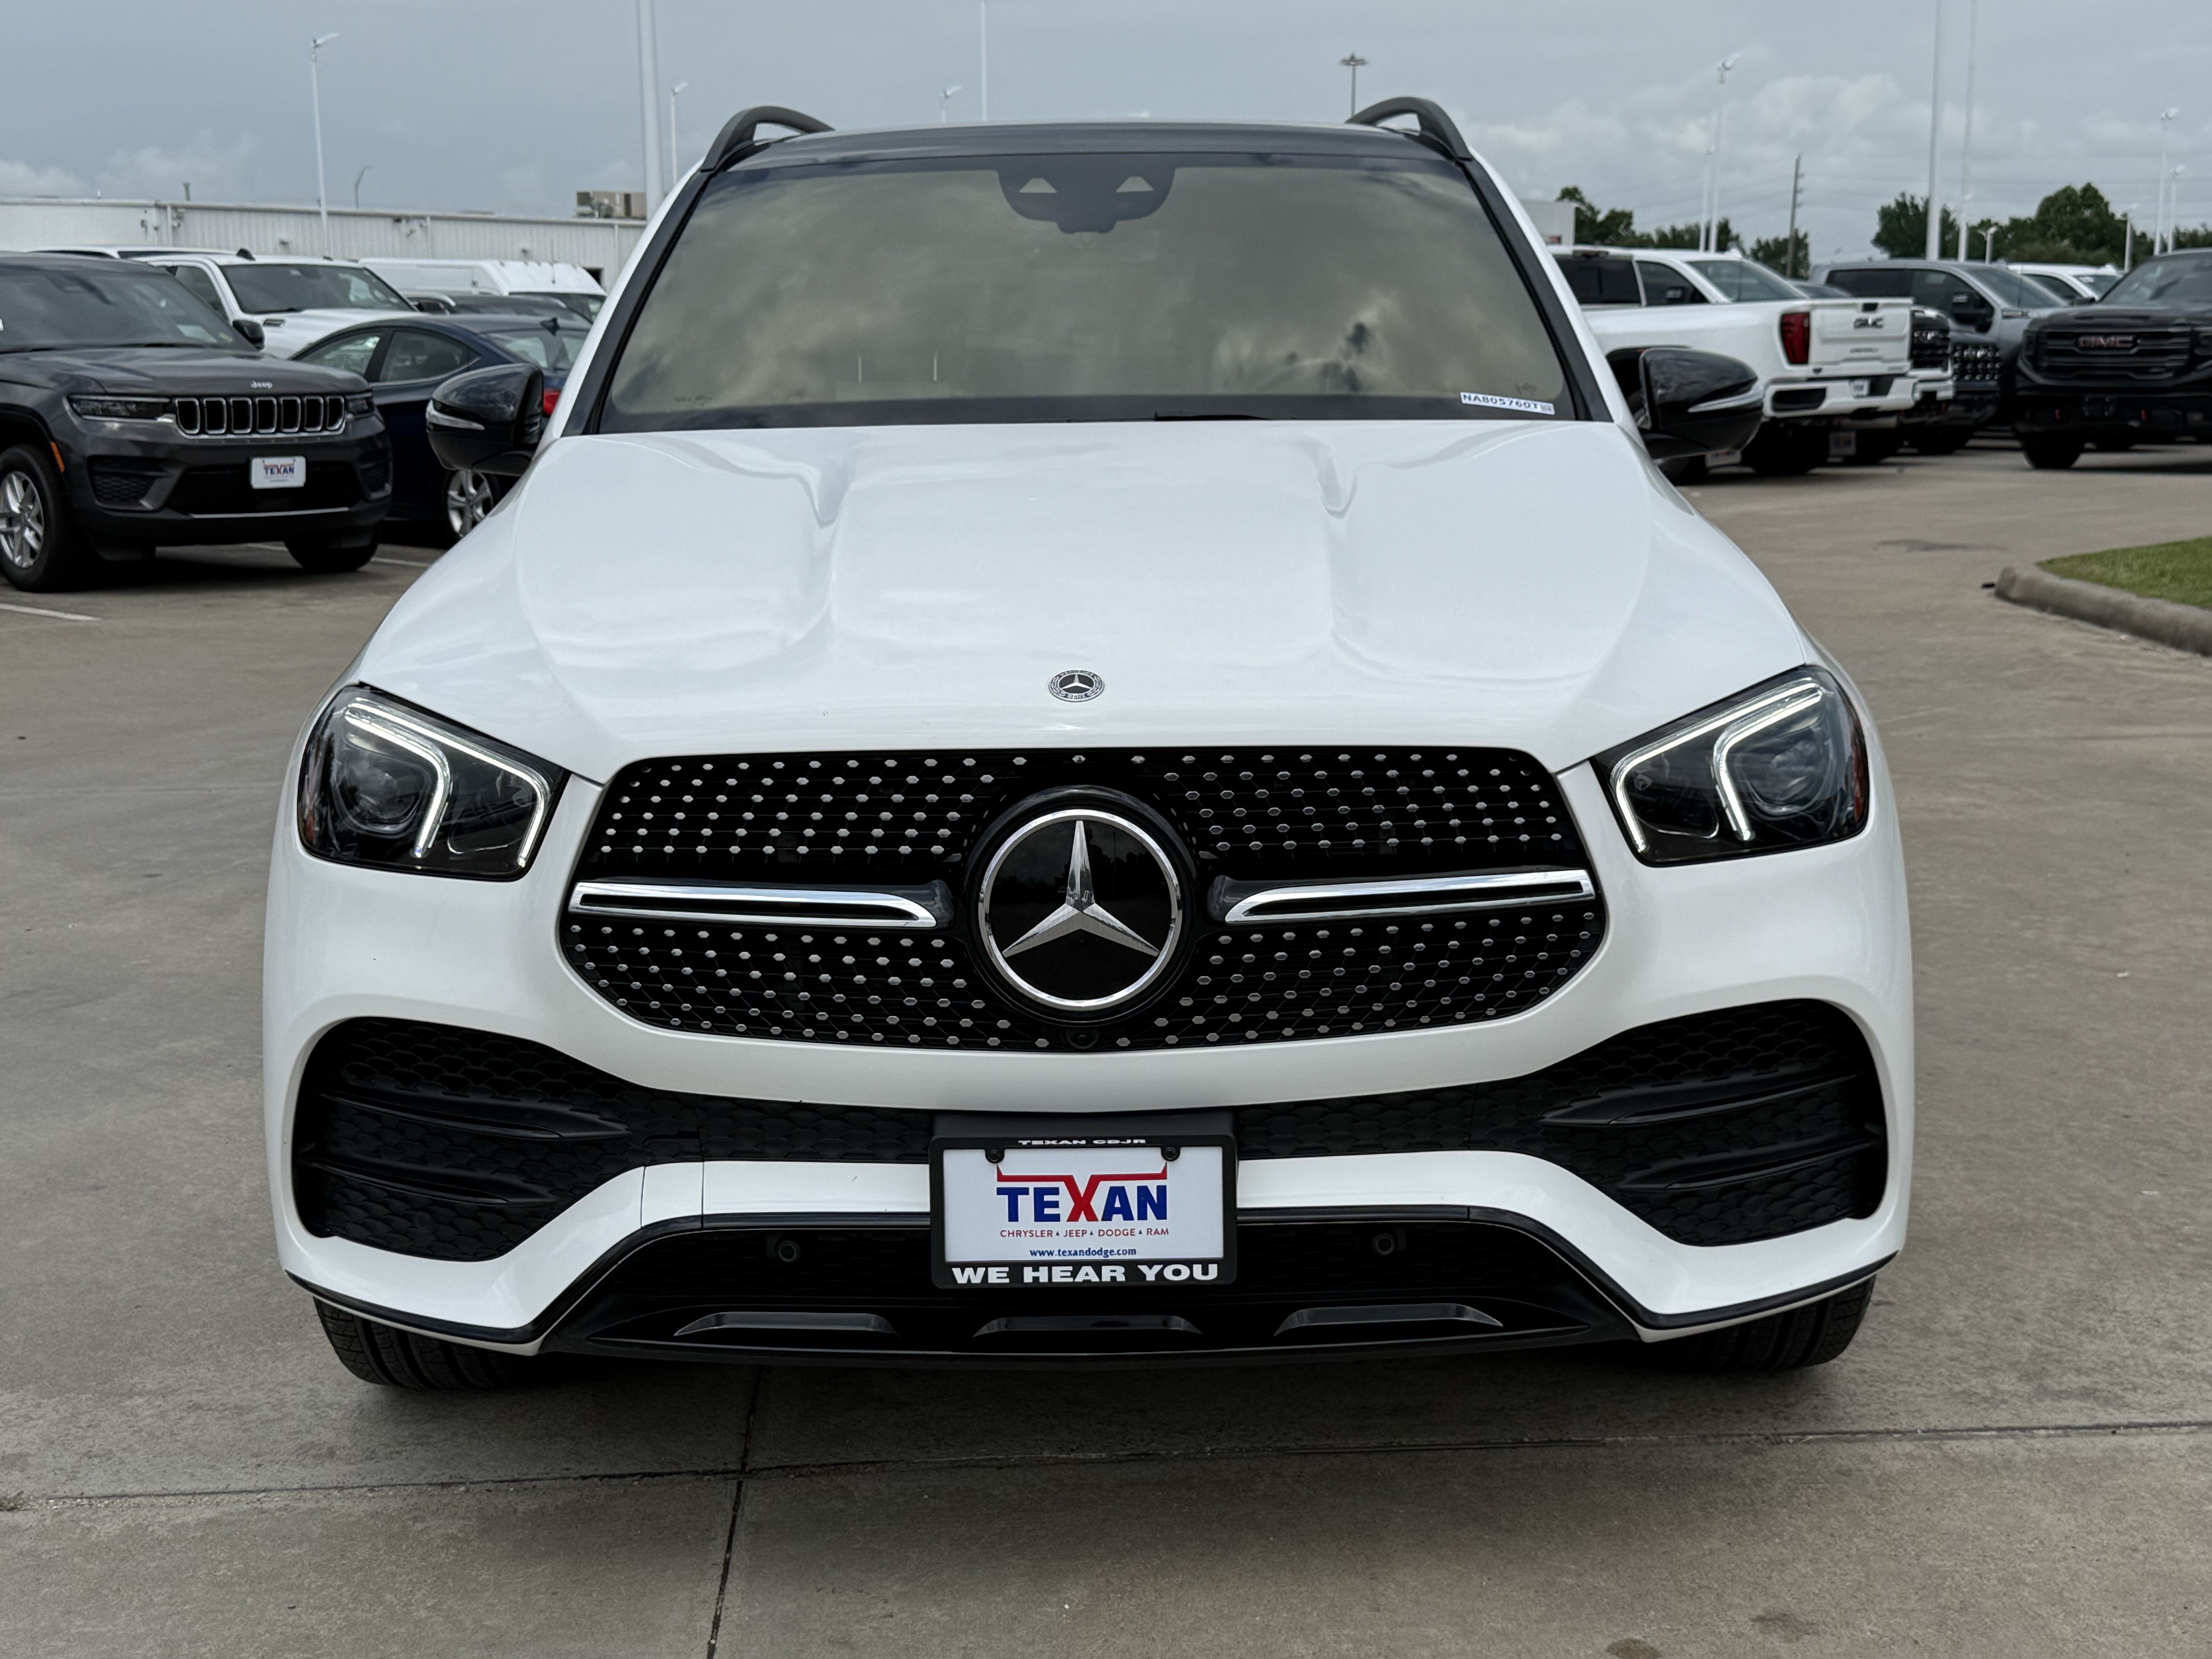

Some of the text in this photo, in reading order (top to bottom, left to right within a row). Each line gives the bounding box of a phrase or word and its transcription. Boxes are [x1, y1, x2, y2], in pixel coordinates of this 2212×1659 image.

[2078, 335, 2134, 348] GMC
[251, 381, 273, 389] Jeep
[264, 464, 294, 475] TEXAN
[996, 1174, 1168, 1222] TEXAN
[1000, 1228, 1169, 1238] CHRYSLER JEEP DODGE RAM
[1029, 1247, 1137, 1258] www.texandodge.com
[951, 1263, 1218, 1284] WE HEAR YOU
